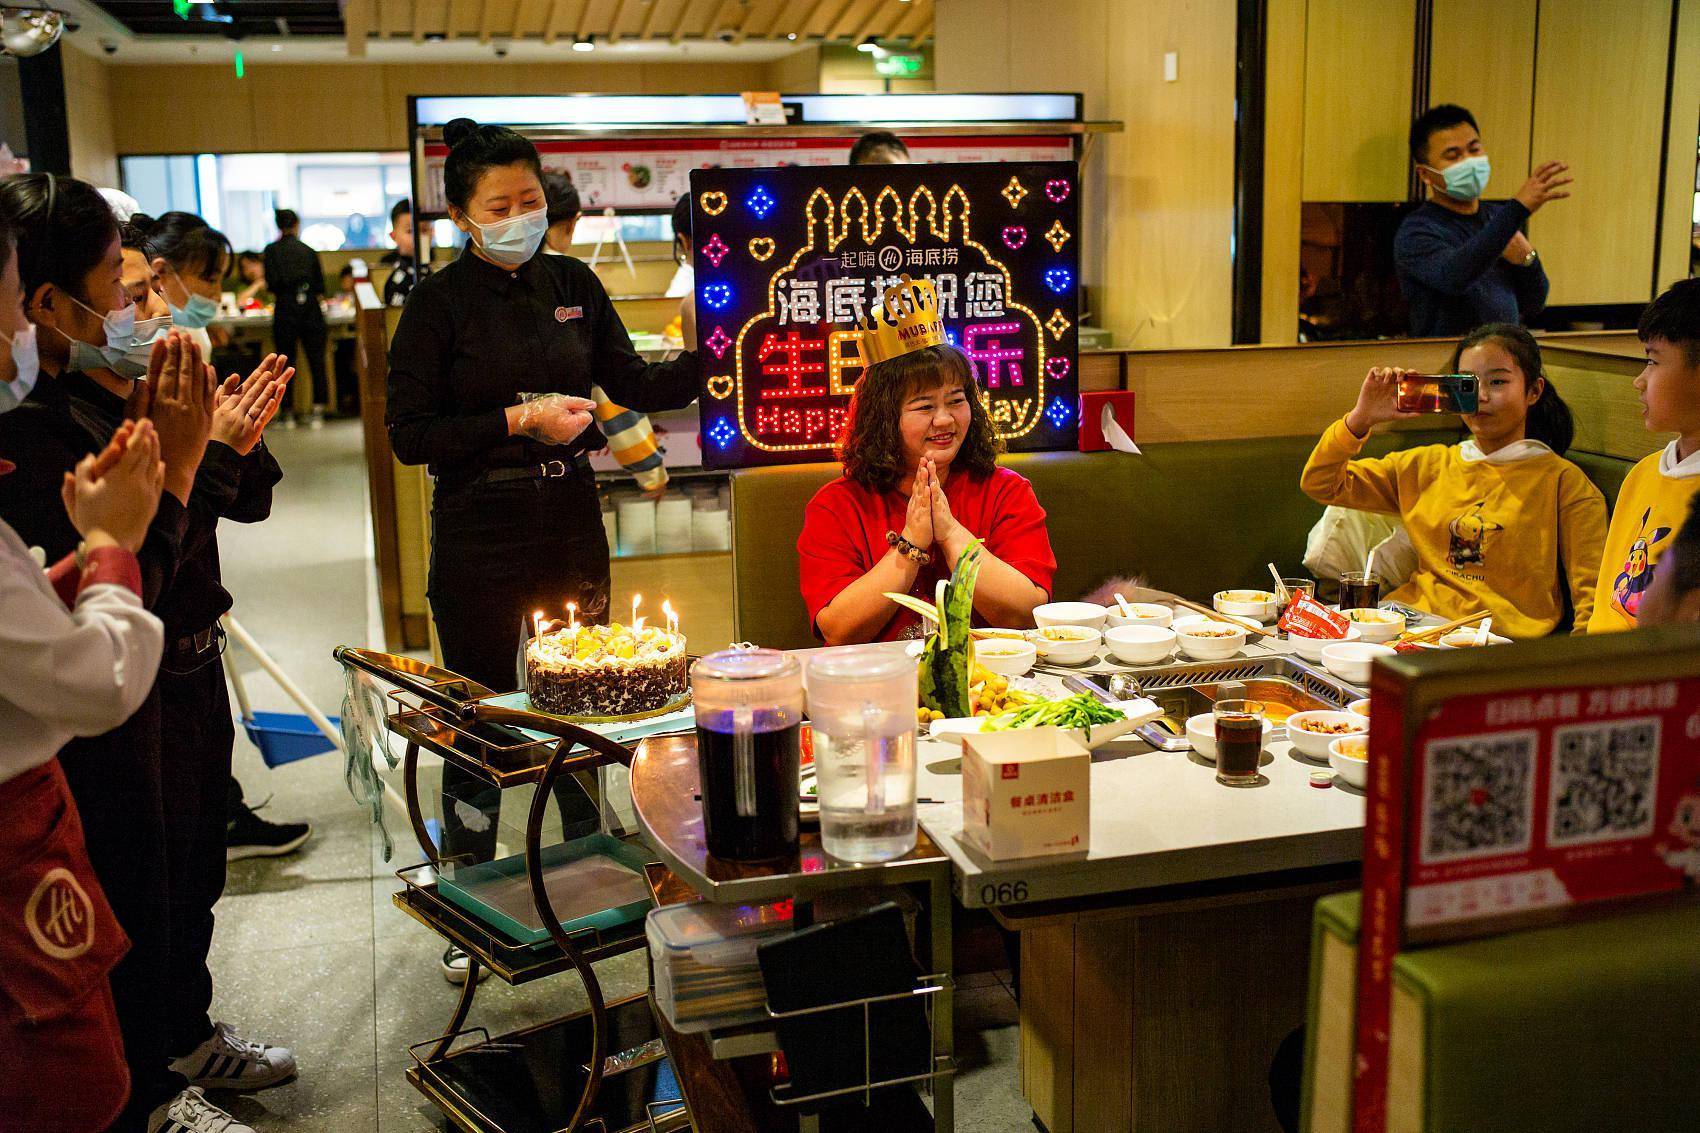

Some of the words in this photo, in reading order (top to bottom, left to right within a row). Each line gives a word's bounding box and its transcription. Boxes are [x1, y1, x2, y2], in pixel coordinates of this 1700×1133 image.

[821, 250, 876, 269] 一起嗨
[905, 247, 959, 266] 海底捞
[758, 322, 1025, 400] 生日乐
[756, 404, 851, 440] Happ
[1446, 569, 1485, 581] IKACHU
[981, 881, 1029, 907] 066
